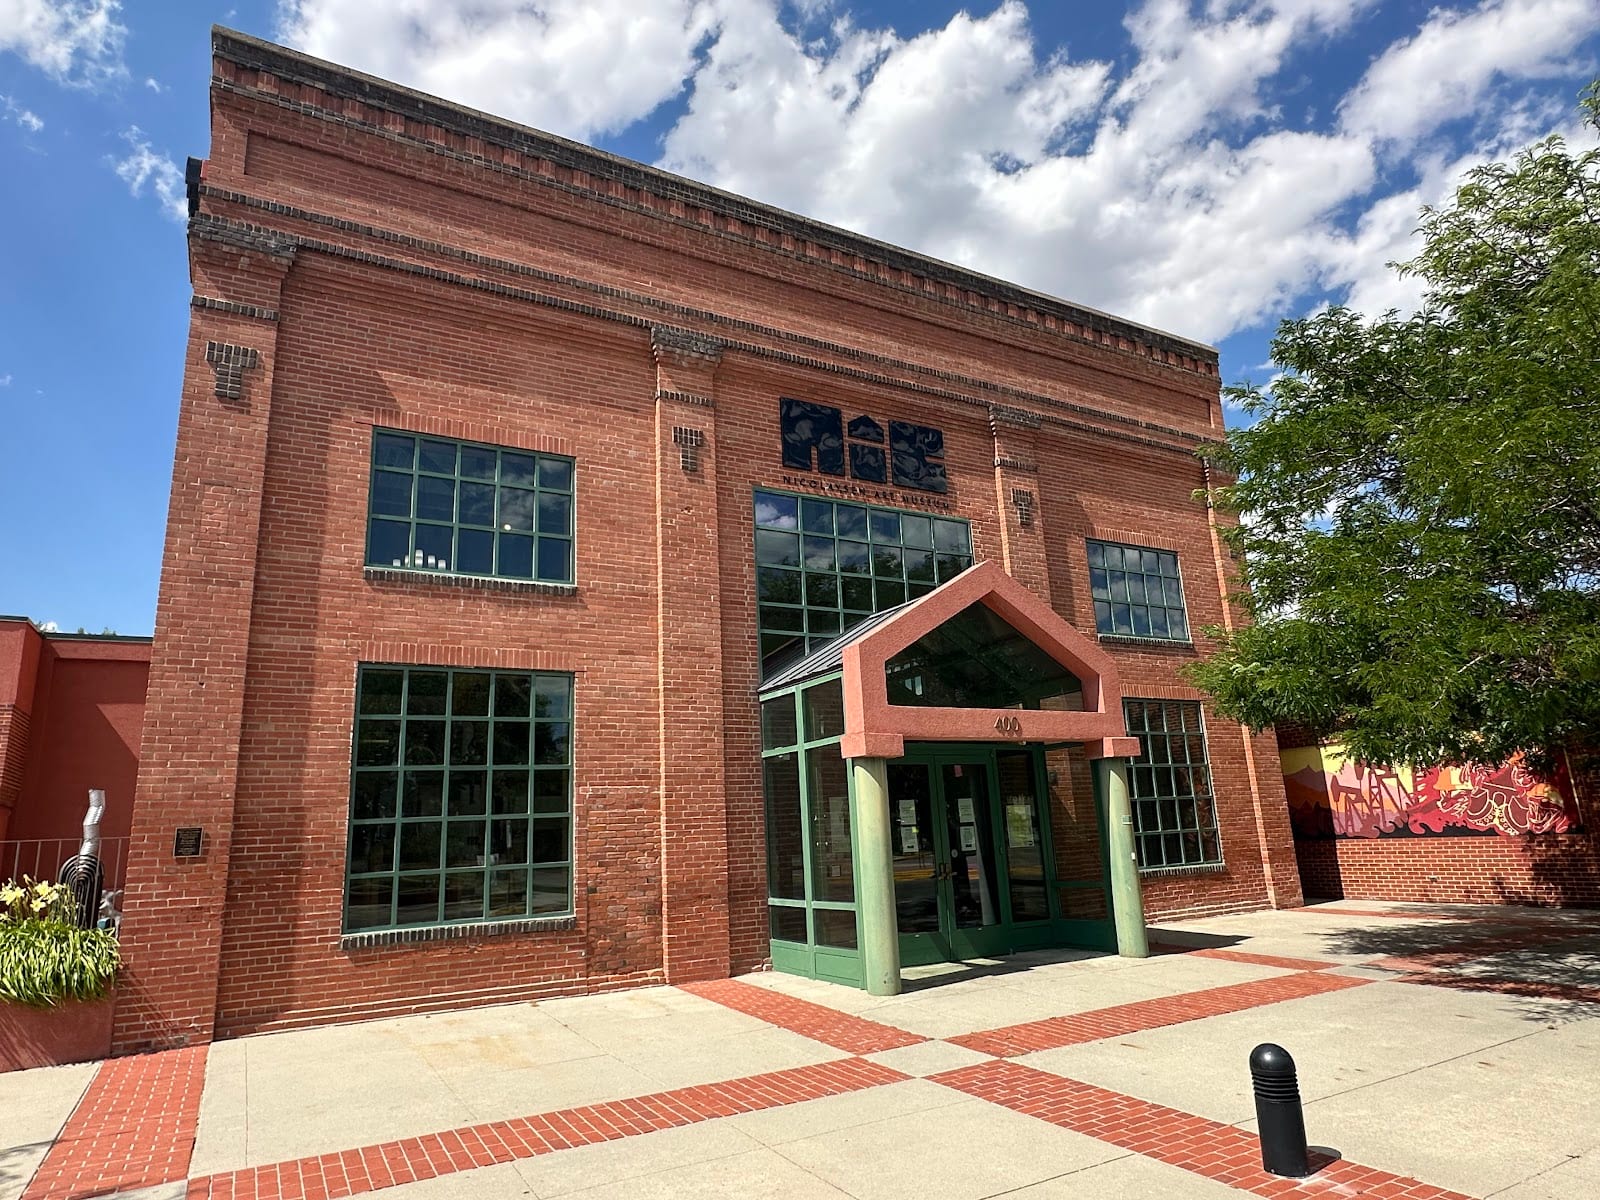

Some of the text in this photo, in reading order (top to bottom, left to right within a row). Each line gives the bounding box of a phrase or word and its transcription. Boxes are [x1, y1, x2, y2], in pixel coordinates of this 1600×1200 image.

[783, 475, 949, 509] NICOLAYSEN ART MUSEUM
[994, 716, 1020, 732] 400
